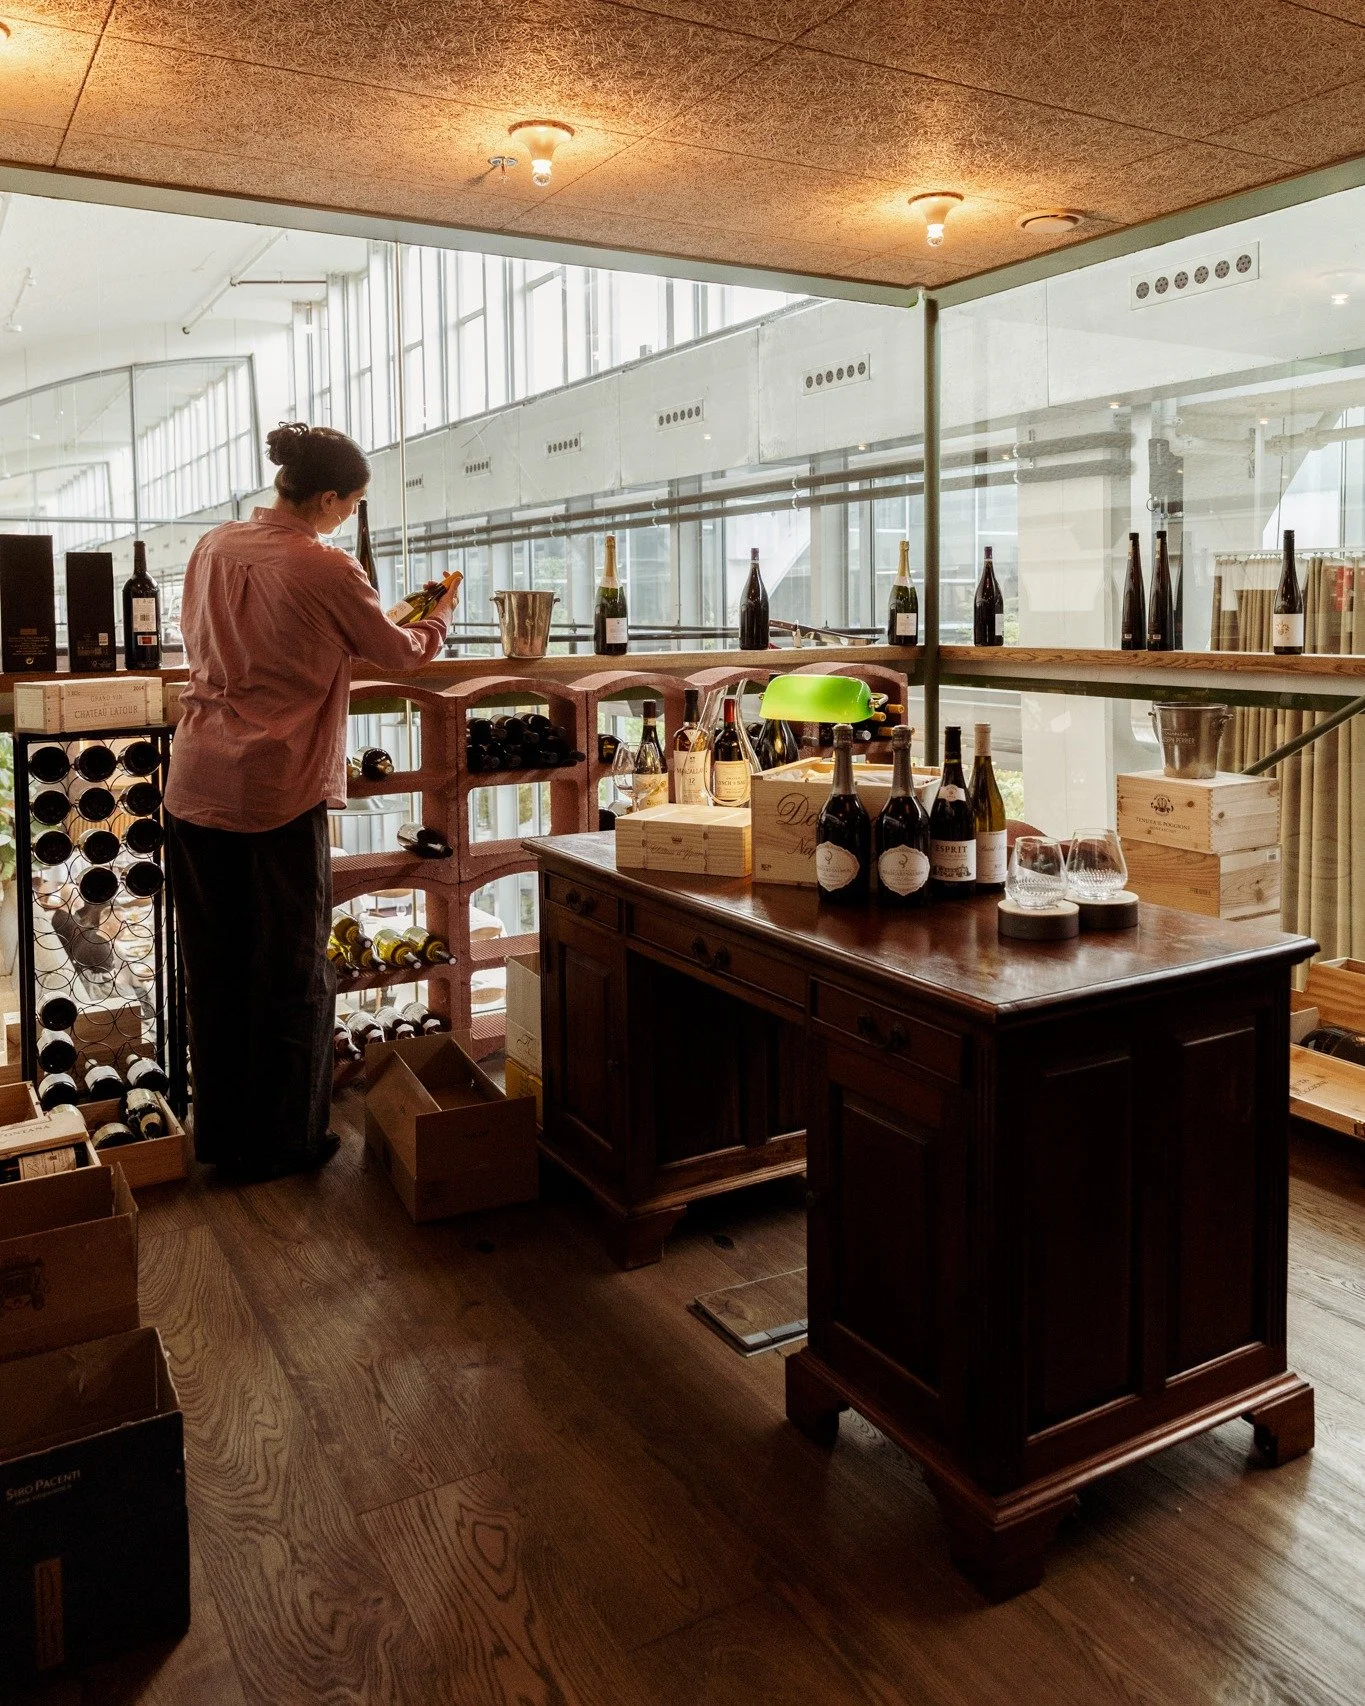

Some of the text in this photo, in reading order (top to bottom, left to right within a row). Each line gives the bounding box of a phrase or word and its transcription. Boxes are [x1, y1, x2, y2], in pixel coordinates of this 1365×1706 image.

[74, 705, 138, 719] CHATEAU LATOUR
[935, 845, 968, 853] ESPRIT
[6, 1485, 34, 1500] SIRO
[35, 1469, 81, 1491] PACENTI
